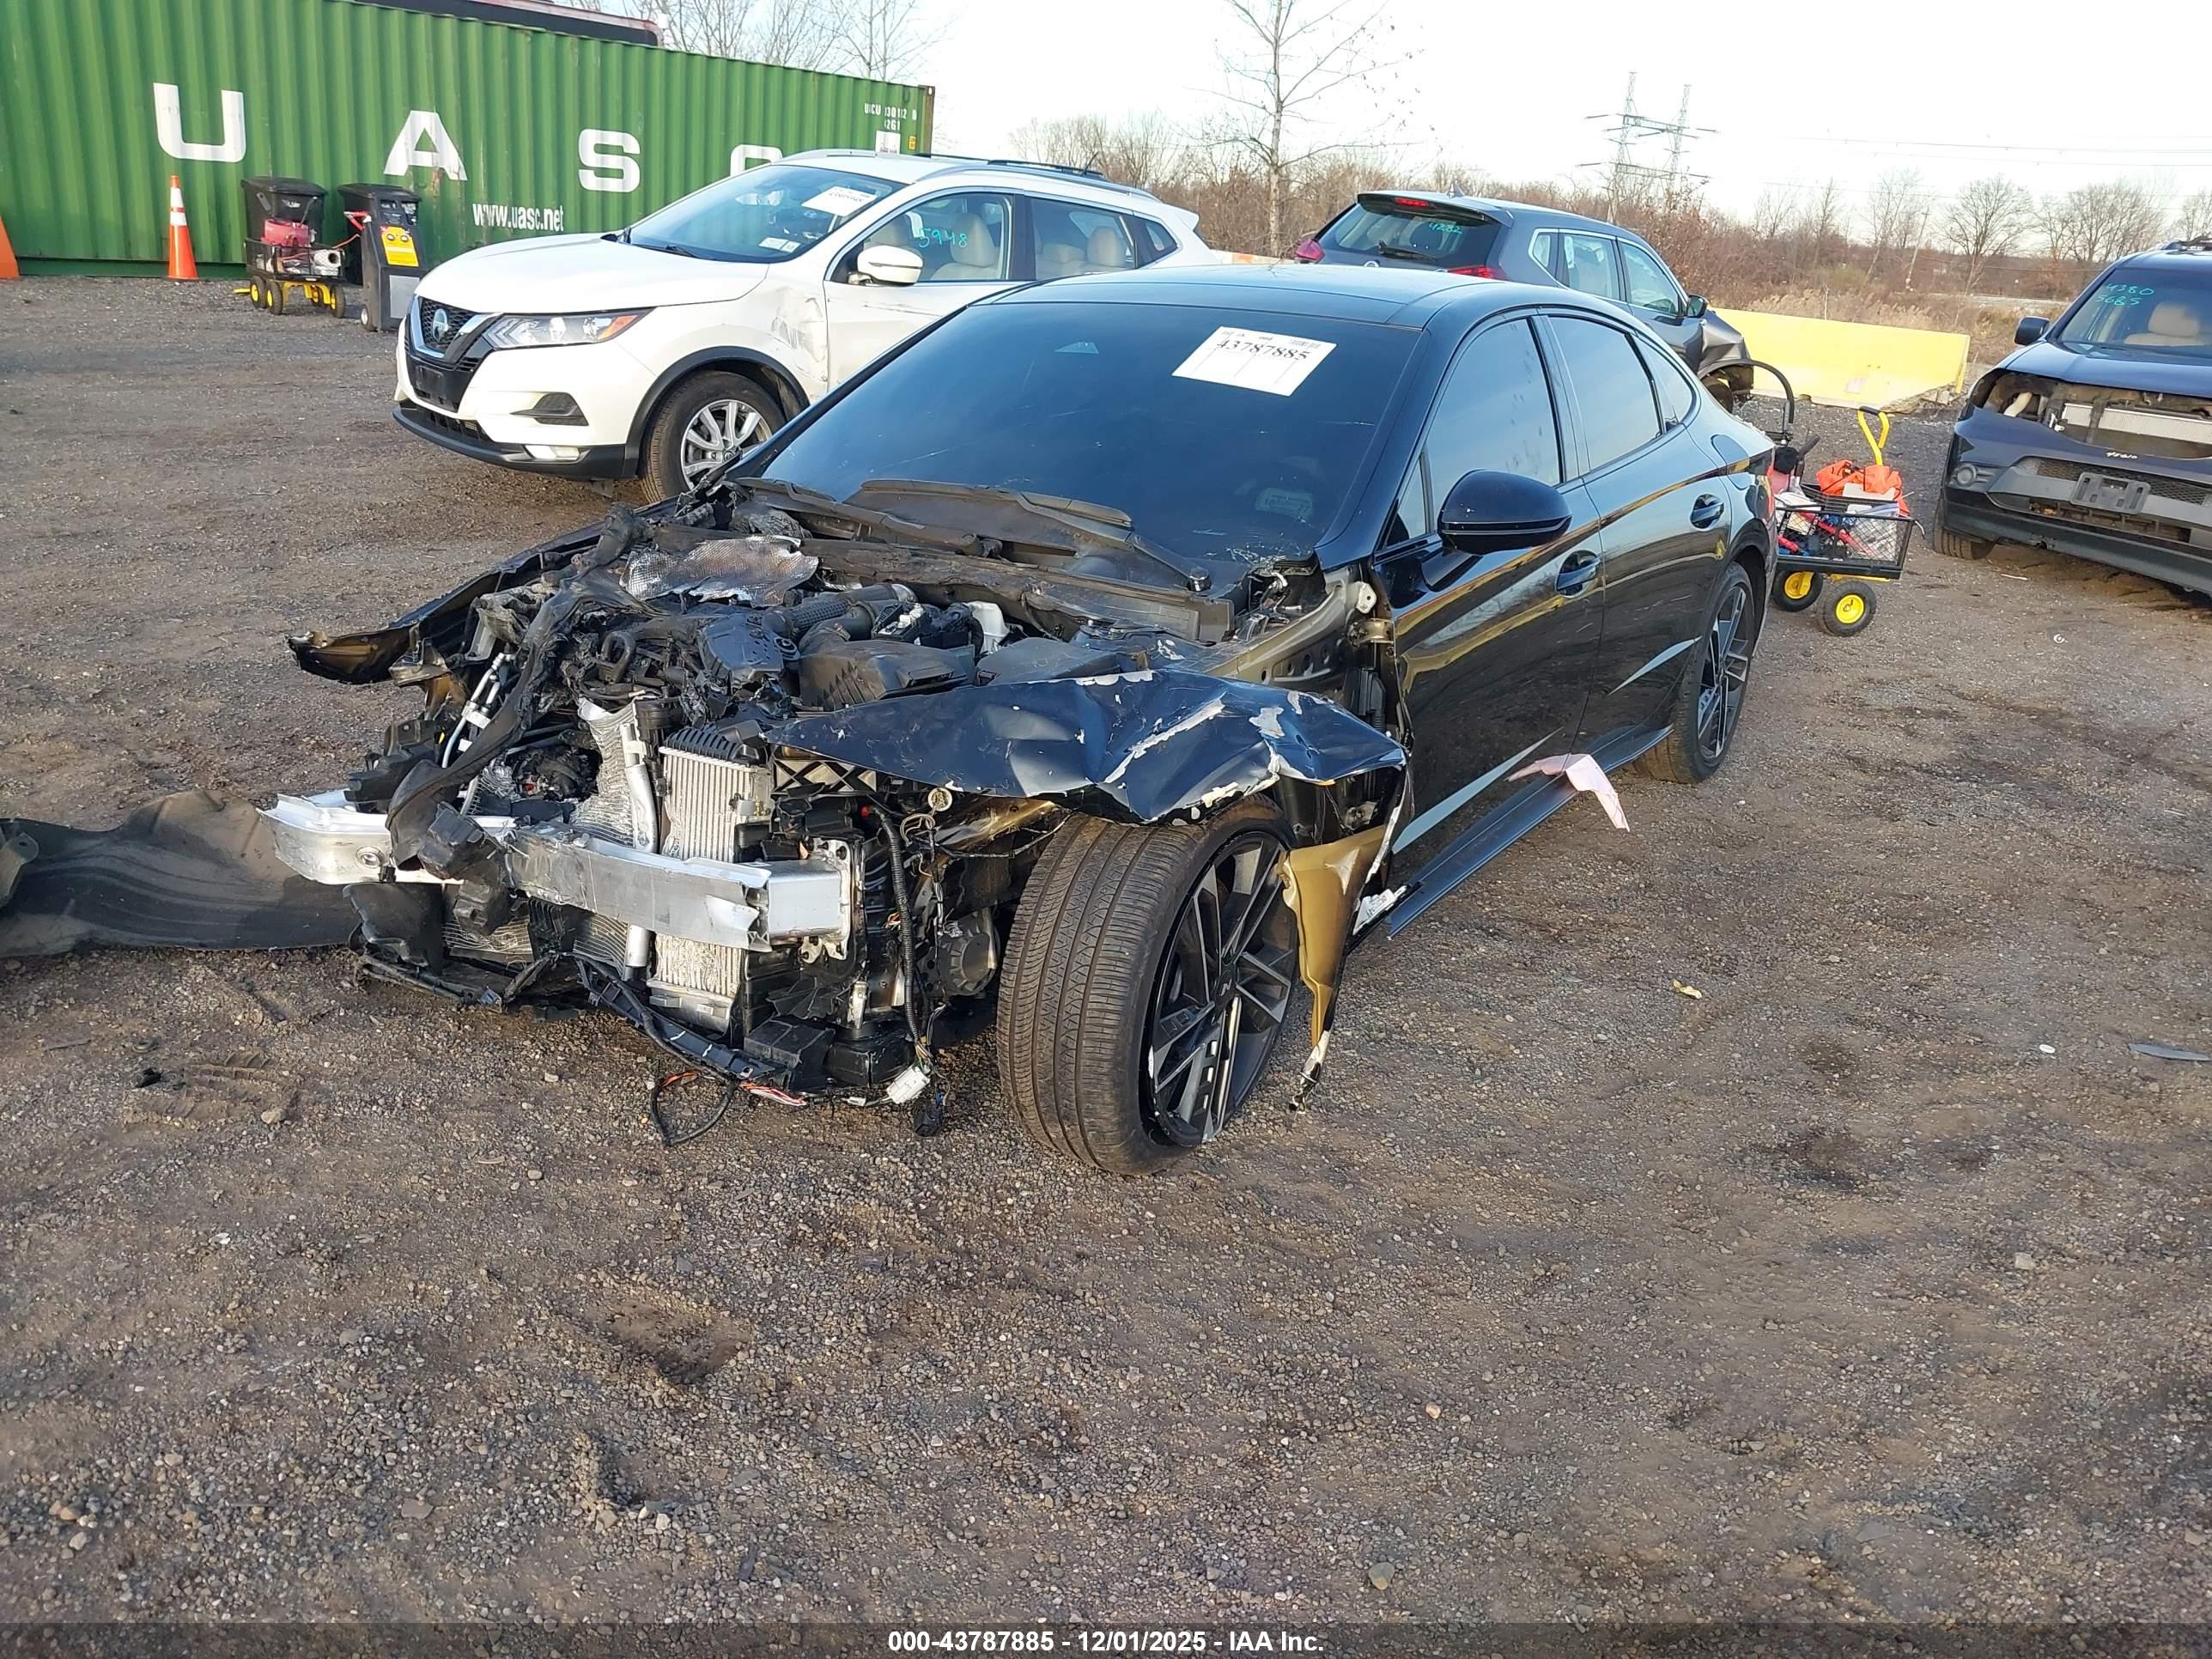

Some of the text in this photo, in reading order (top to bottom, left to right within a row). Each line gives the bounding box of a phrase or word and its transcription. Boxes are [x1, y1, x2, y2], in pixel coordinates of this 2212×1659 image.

[472, 203, 563, 232] www.uasc.net
[919, 227, 968, 248] 5948
[1216, 338, 1311, 361] 43787885
